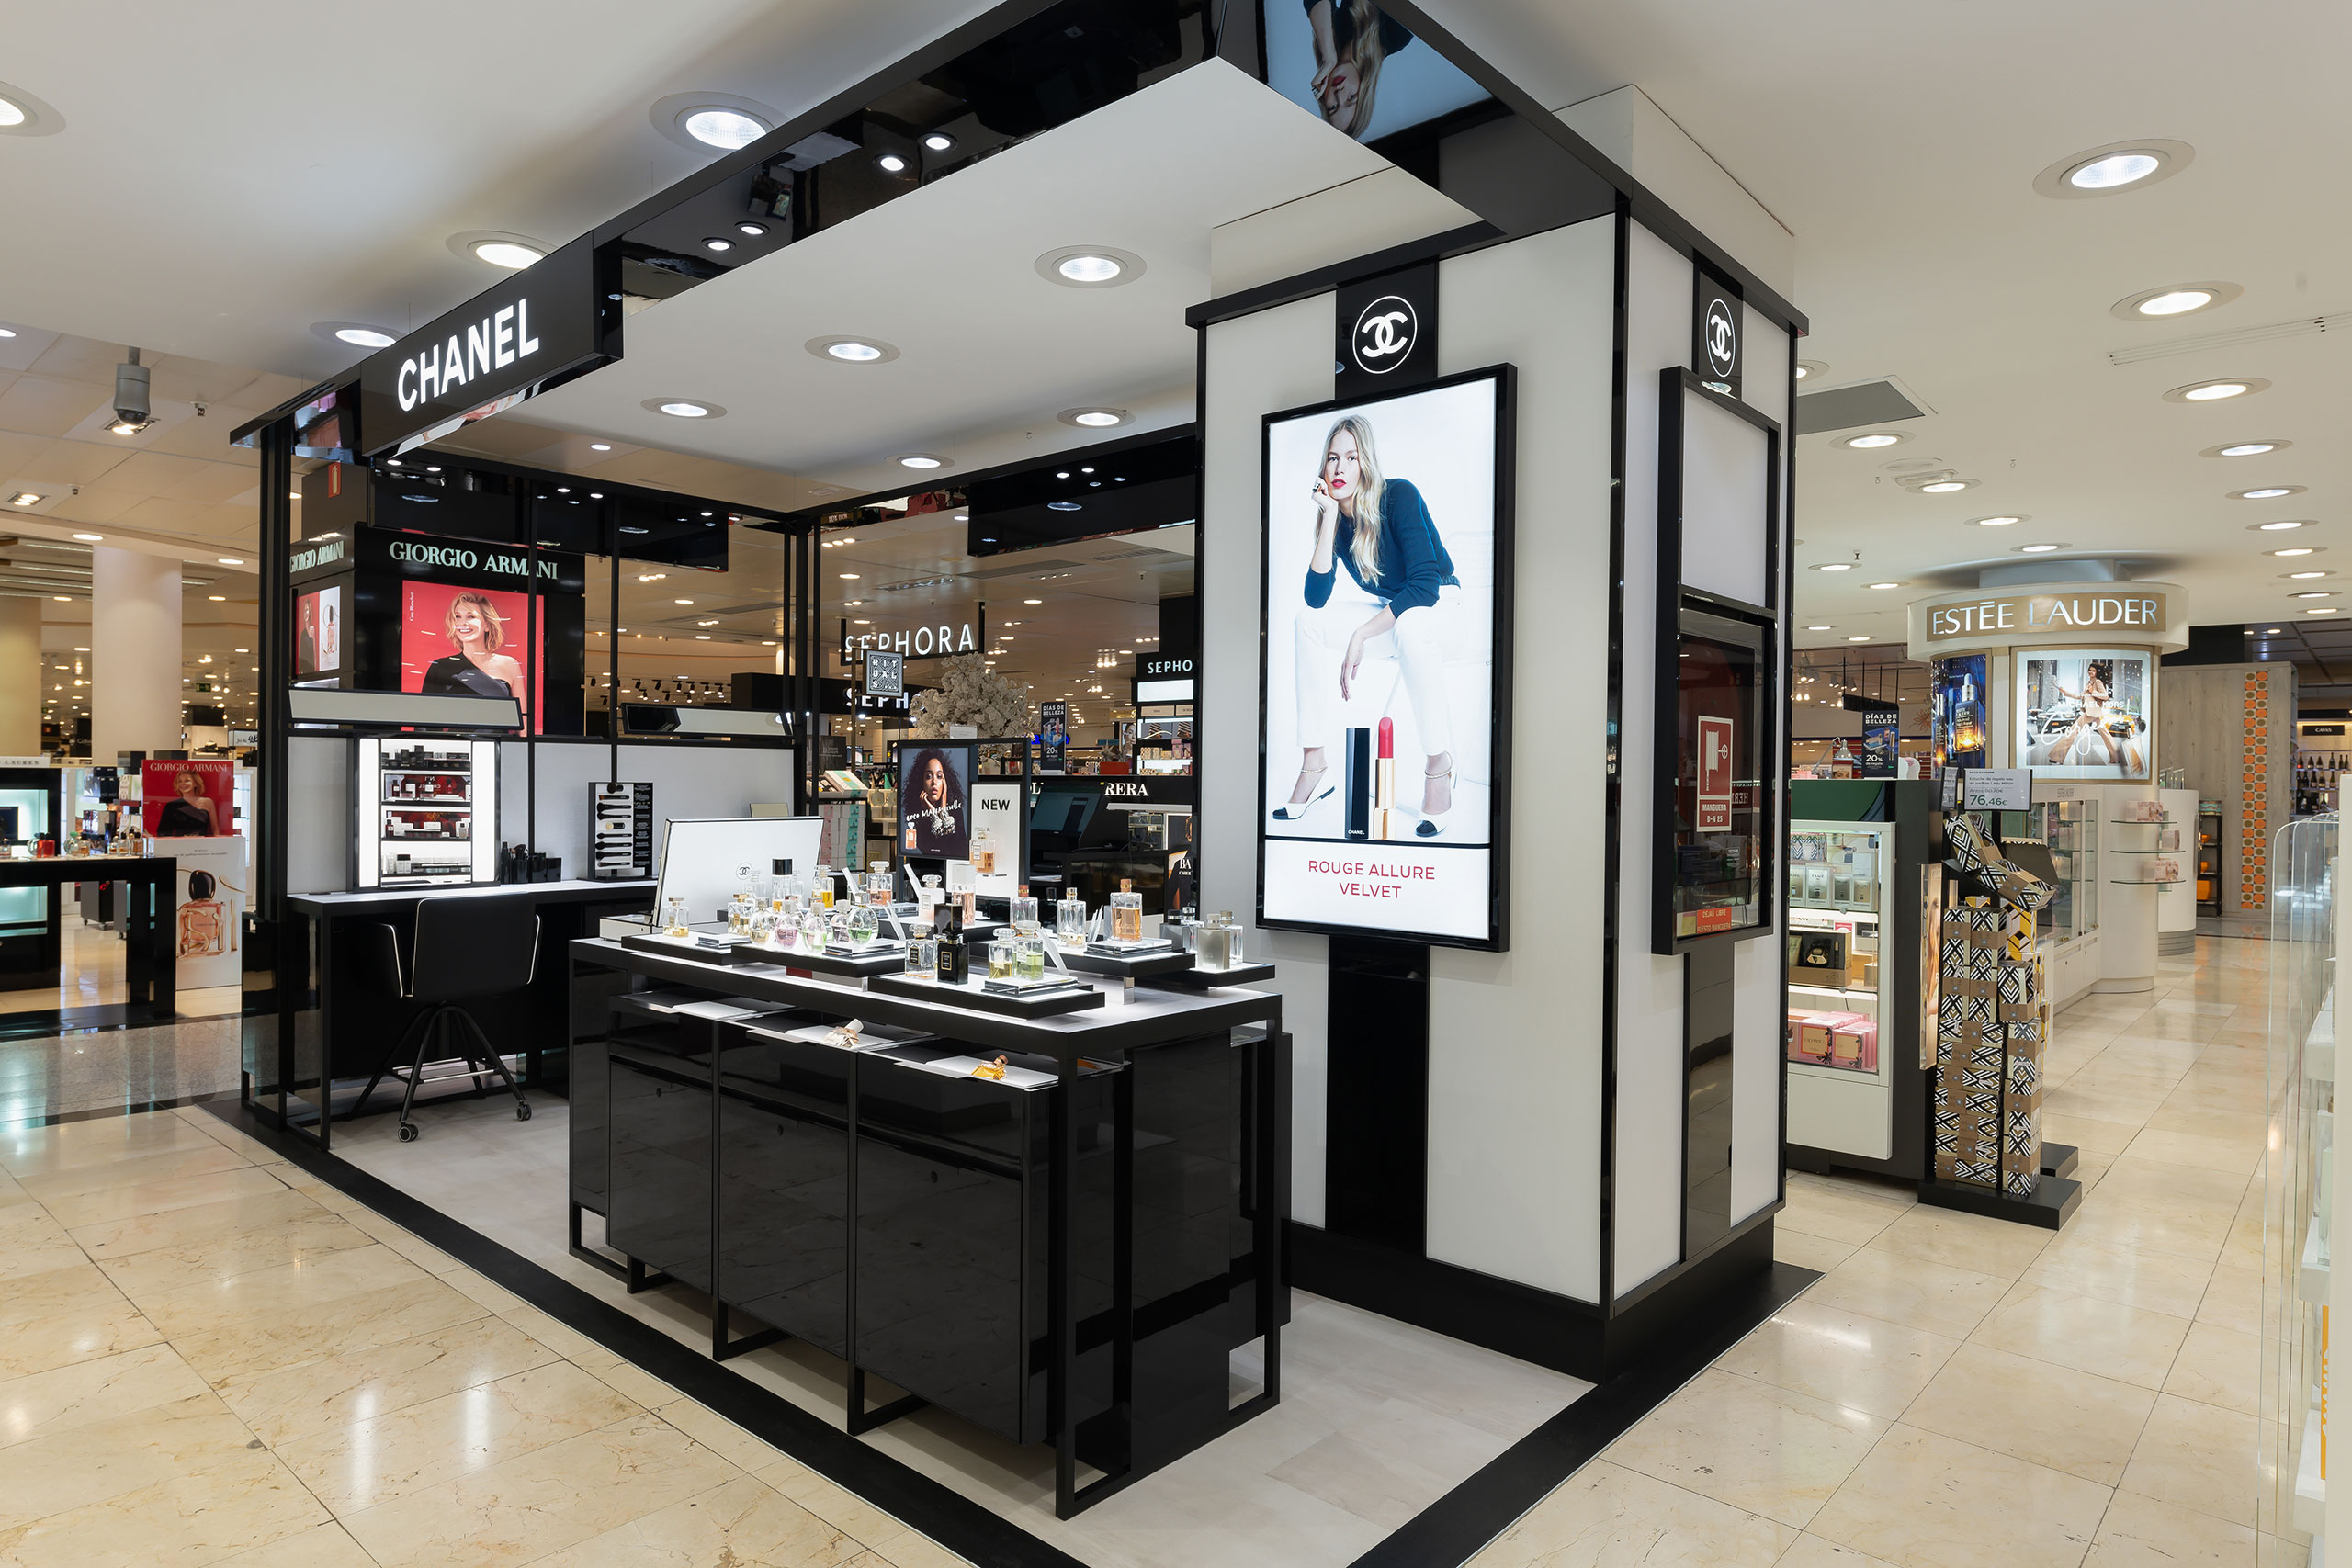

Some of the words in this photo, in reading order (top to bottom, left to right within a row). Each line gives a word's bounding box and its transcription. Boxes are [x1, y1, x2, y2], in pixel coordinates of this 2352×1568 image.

[397, 299, 539, 412] CHANEL
[289, 549, 317, 573] GIORGIO
[317, 540, 345, 566] ARMANI
[389, 541, 478, 569] GIORGIO
[1932, 601, 2014, 635] ESTÉE
[2029, 599, 2158, 626] LAUDER
[845, 624, 974, 661] SEPHORA
[1866, 754, 1883, 762] 20%
[150, 763, 189, 772] GIORGIO
[192, 763, 227, 772] ARMANI
[981, 799, 1011, 811] NEW
[1702, 803, 1727, 812] MANGUERA
[1970, 795, 2007, 807] 76,46€
[1308, 860, 1364, 874] ROUGE
[1368, 863, 1435, 879] ALLURE
[1339, 882, 1402, 898] VELVET
[1697, 924, 1711, 932] PUESTO
[1712, 921, 1731, 931] MANGUERA
